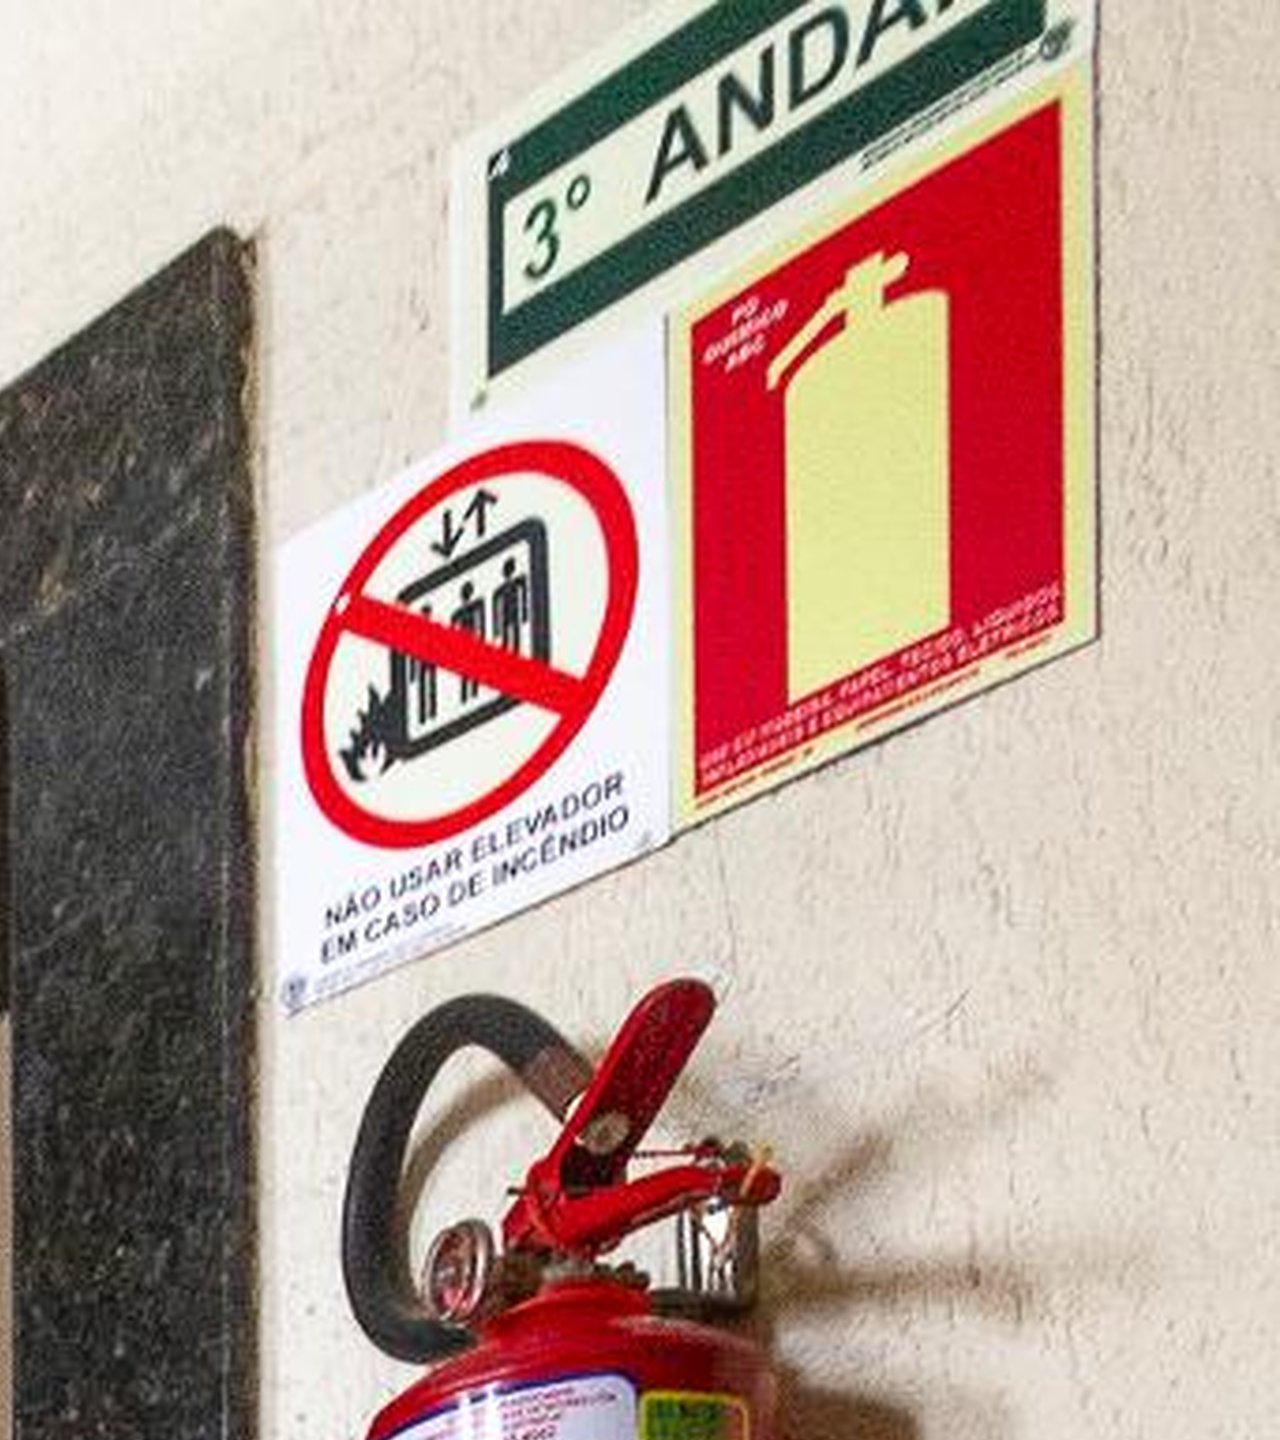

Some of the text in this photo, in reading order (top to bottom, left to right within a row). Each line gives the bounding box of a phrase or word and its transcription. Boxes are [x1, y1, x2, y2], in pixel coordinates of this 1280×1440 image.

[645, 0, 955, 204] ANDA
[320, 931, 359, 966] EM
[364, 894, 442, 945] CASO
[447, 871, 487, 909] DE
[492, 805, 631, 888] INCÊNDIO
[324, 771, 625, 930] NÃO USAR ELEVADOR
